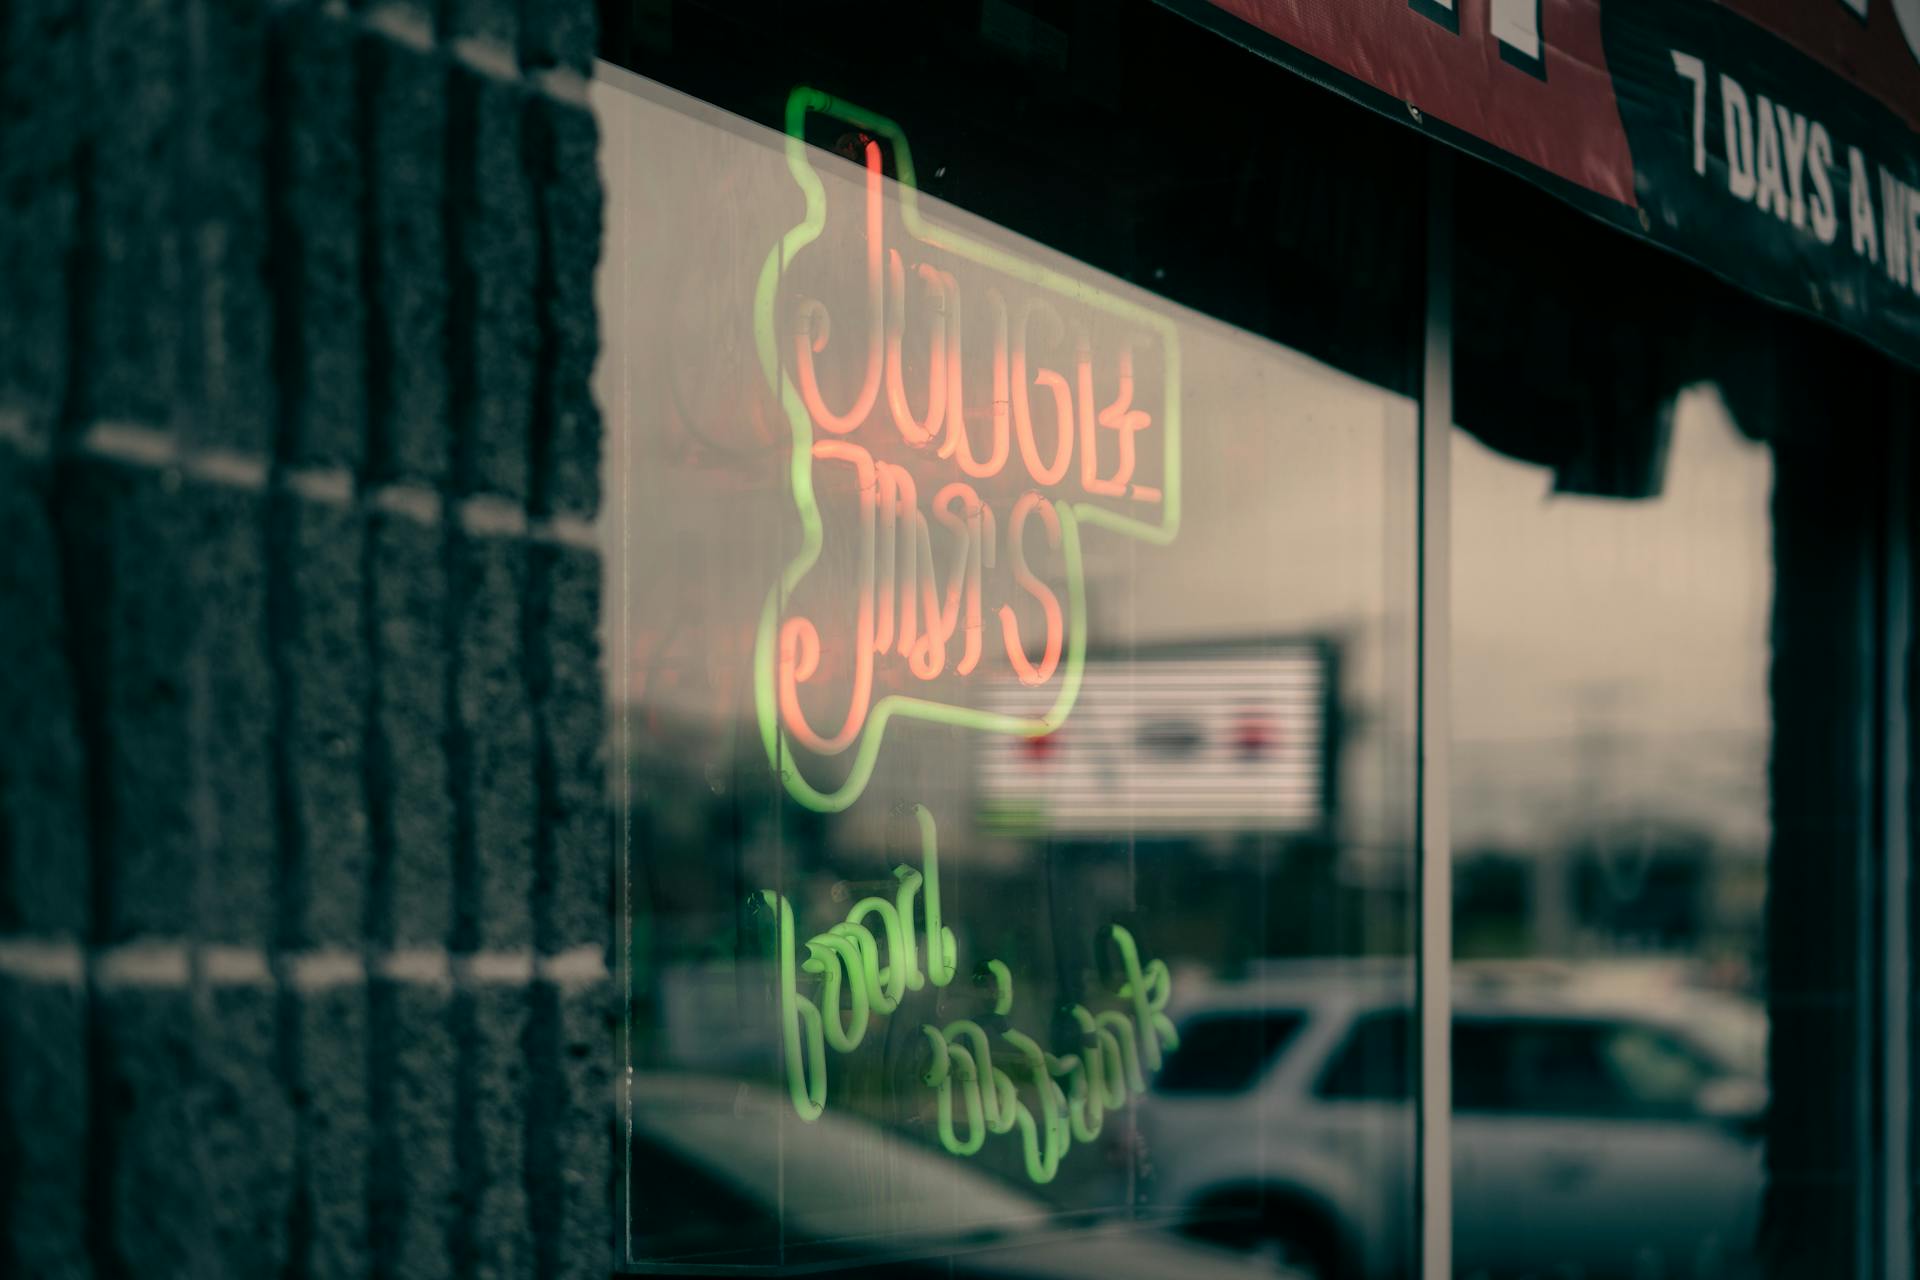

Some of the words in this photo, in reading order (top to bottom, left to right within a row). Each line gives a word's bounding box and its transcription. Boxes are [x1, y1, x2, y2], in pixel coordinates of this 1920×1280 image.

[1669, 48, 1707, 178] 7
[1719, 71, 1838, 247] DAYS
[1847, 144, 1879, 267] A
